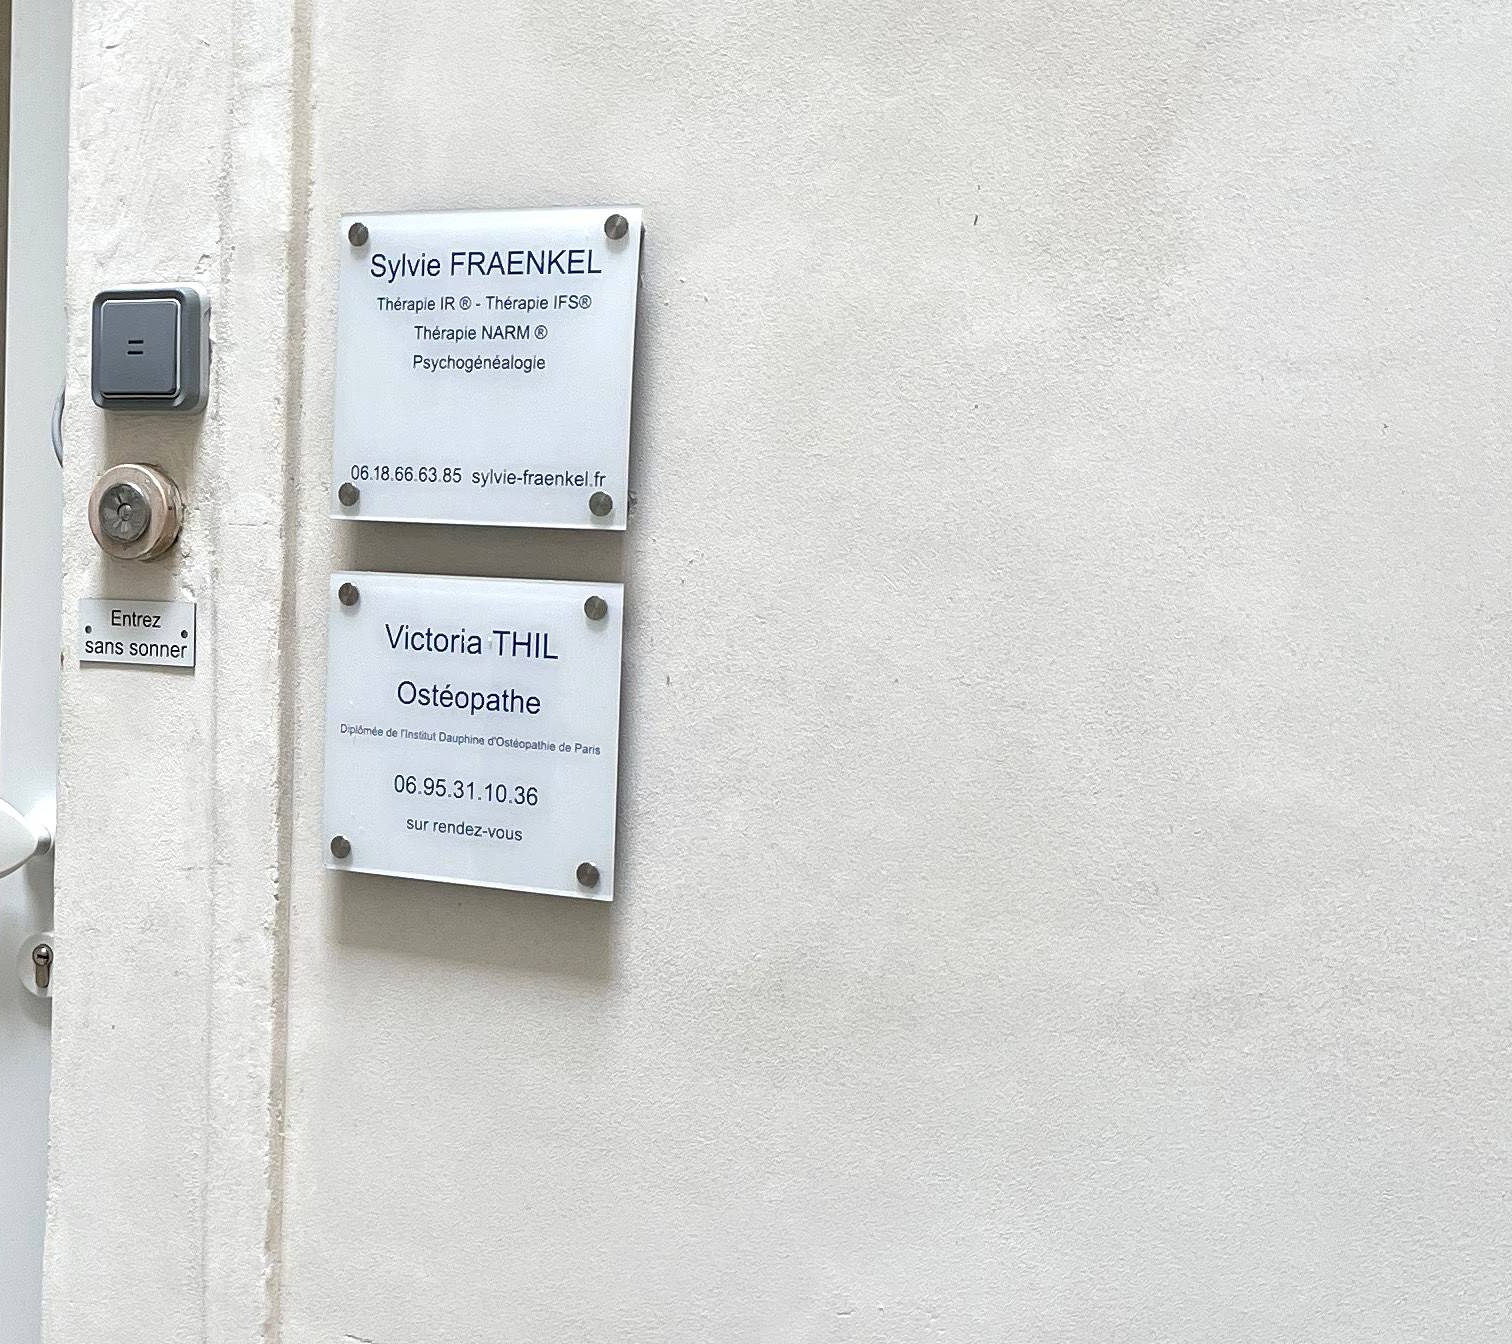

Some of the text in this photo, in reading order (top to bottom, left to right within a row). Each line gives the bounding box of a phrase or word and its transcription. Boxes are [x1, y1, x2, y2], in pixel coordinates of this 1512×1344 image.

[370, 249, 602, 283] Sylvie FRAENKEL
[377, 296, 435, 314] Thérapie
[440, 296, 455, 310] IR
[485, 295, 548, 313] Thérapie
[414, 326, 476, 343] Thérapie
[481, 325, 530, 340] NARM
[413, 354, 546, 373] Psychogénéalogie
[350, 465, 606, 488] 06.18.66.63.85 sylvie-fraenkel.fr
[111, 610, 161, 629] Entrez
[85, 639, 187, 658] sans sonner
[385, 623, 558, 660] Victoria THIL
[397, 681, 541, 715] Ostéopathe
[386, 727, 398, 738] de
[438, 732, 485, 746] Dauphine
[559, 741, 572, 753] de
[575, 743, 601, 755] Paris
[394, 774, 538, 806] 06.95.31.10.36
[406, 818, 523, 841] sur rendez-vous
